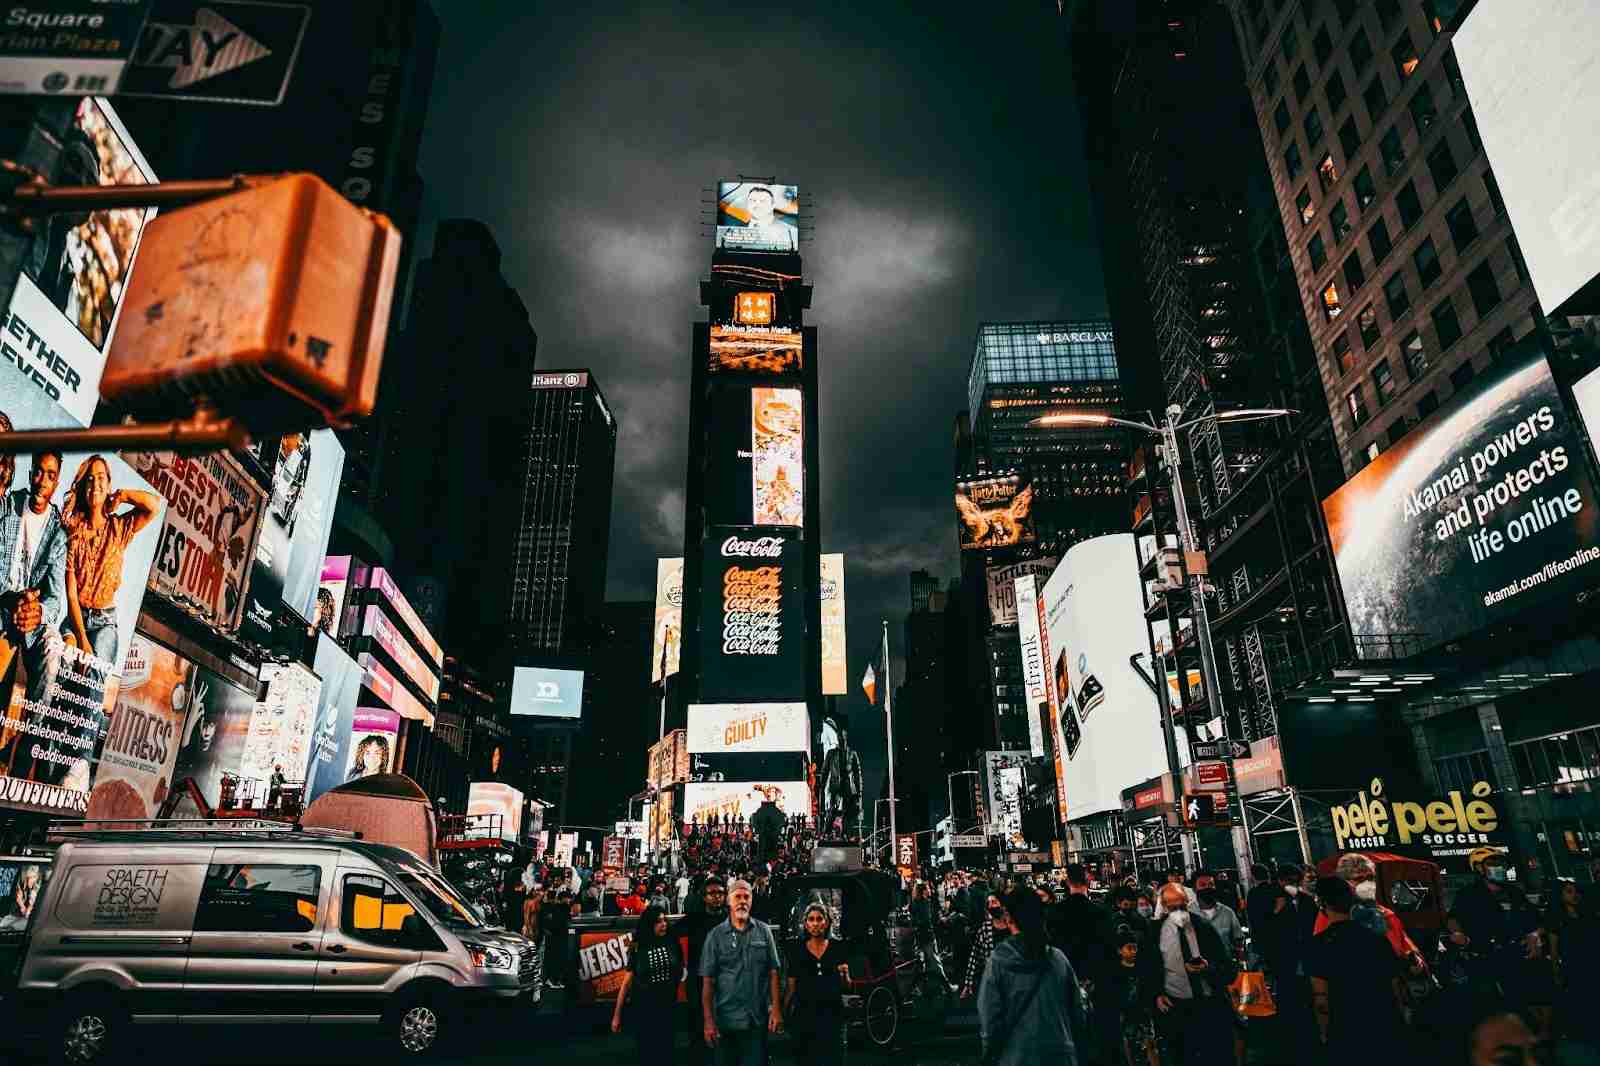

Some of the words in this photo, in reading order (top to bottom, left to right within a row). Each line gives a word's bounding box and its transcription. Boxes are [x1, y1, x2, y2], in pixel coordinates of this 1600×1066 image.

[6, 8, 105, 31] Square
[0, 311, 81, 393] ETHER
[1402, 461, 1470, 523] Akamai
[1471, 405, 1555, 482] powers
[174, 456, 220, 508] BEST
[1436, 507, 1472, 541] and
[1473, 445, 1569, 525] protects
[1467, 525, 1504, 564] life
[1507, 487, 1583, 544] online
[721, 536, 785, 557] Coca-Cola
[994, 564, 1027, 586] LITTLE
[1483, 545, 1600, 607] akamai.com/lifeonline
[723, 638, 779, 655] Coca-Cola
[724, 718, 767, 746] GUILTY
[1349, 837, 1386, 849] SOCCER
[1423, 833, 1489, 844] SOCCER
[103, 869, 168, 888] SPAETH
[98, 887, 164, 905] DESIGN
[577, 933, 633, 982] JERSE
